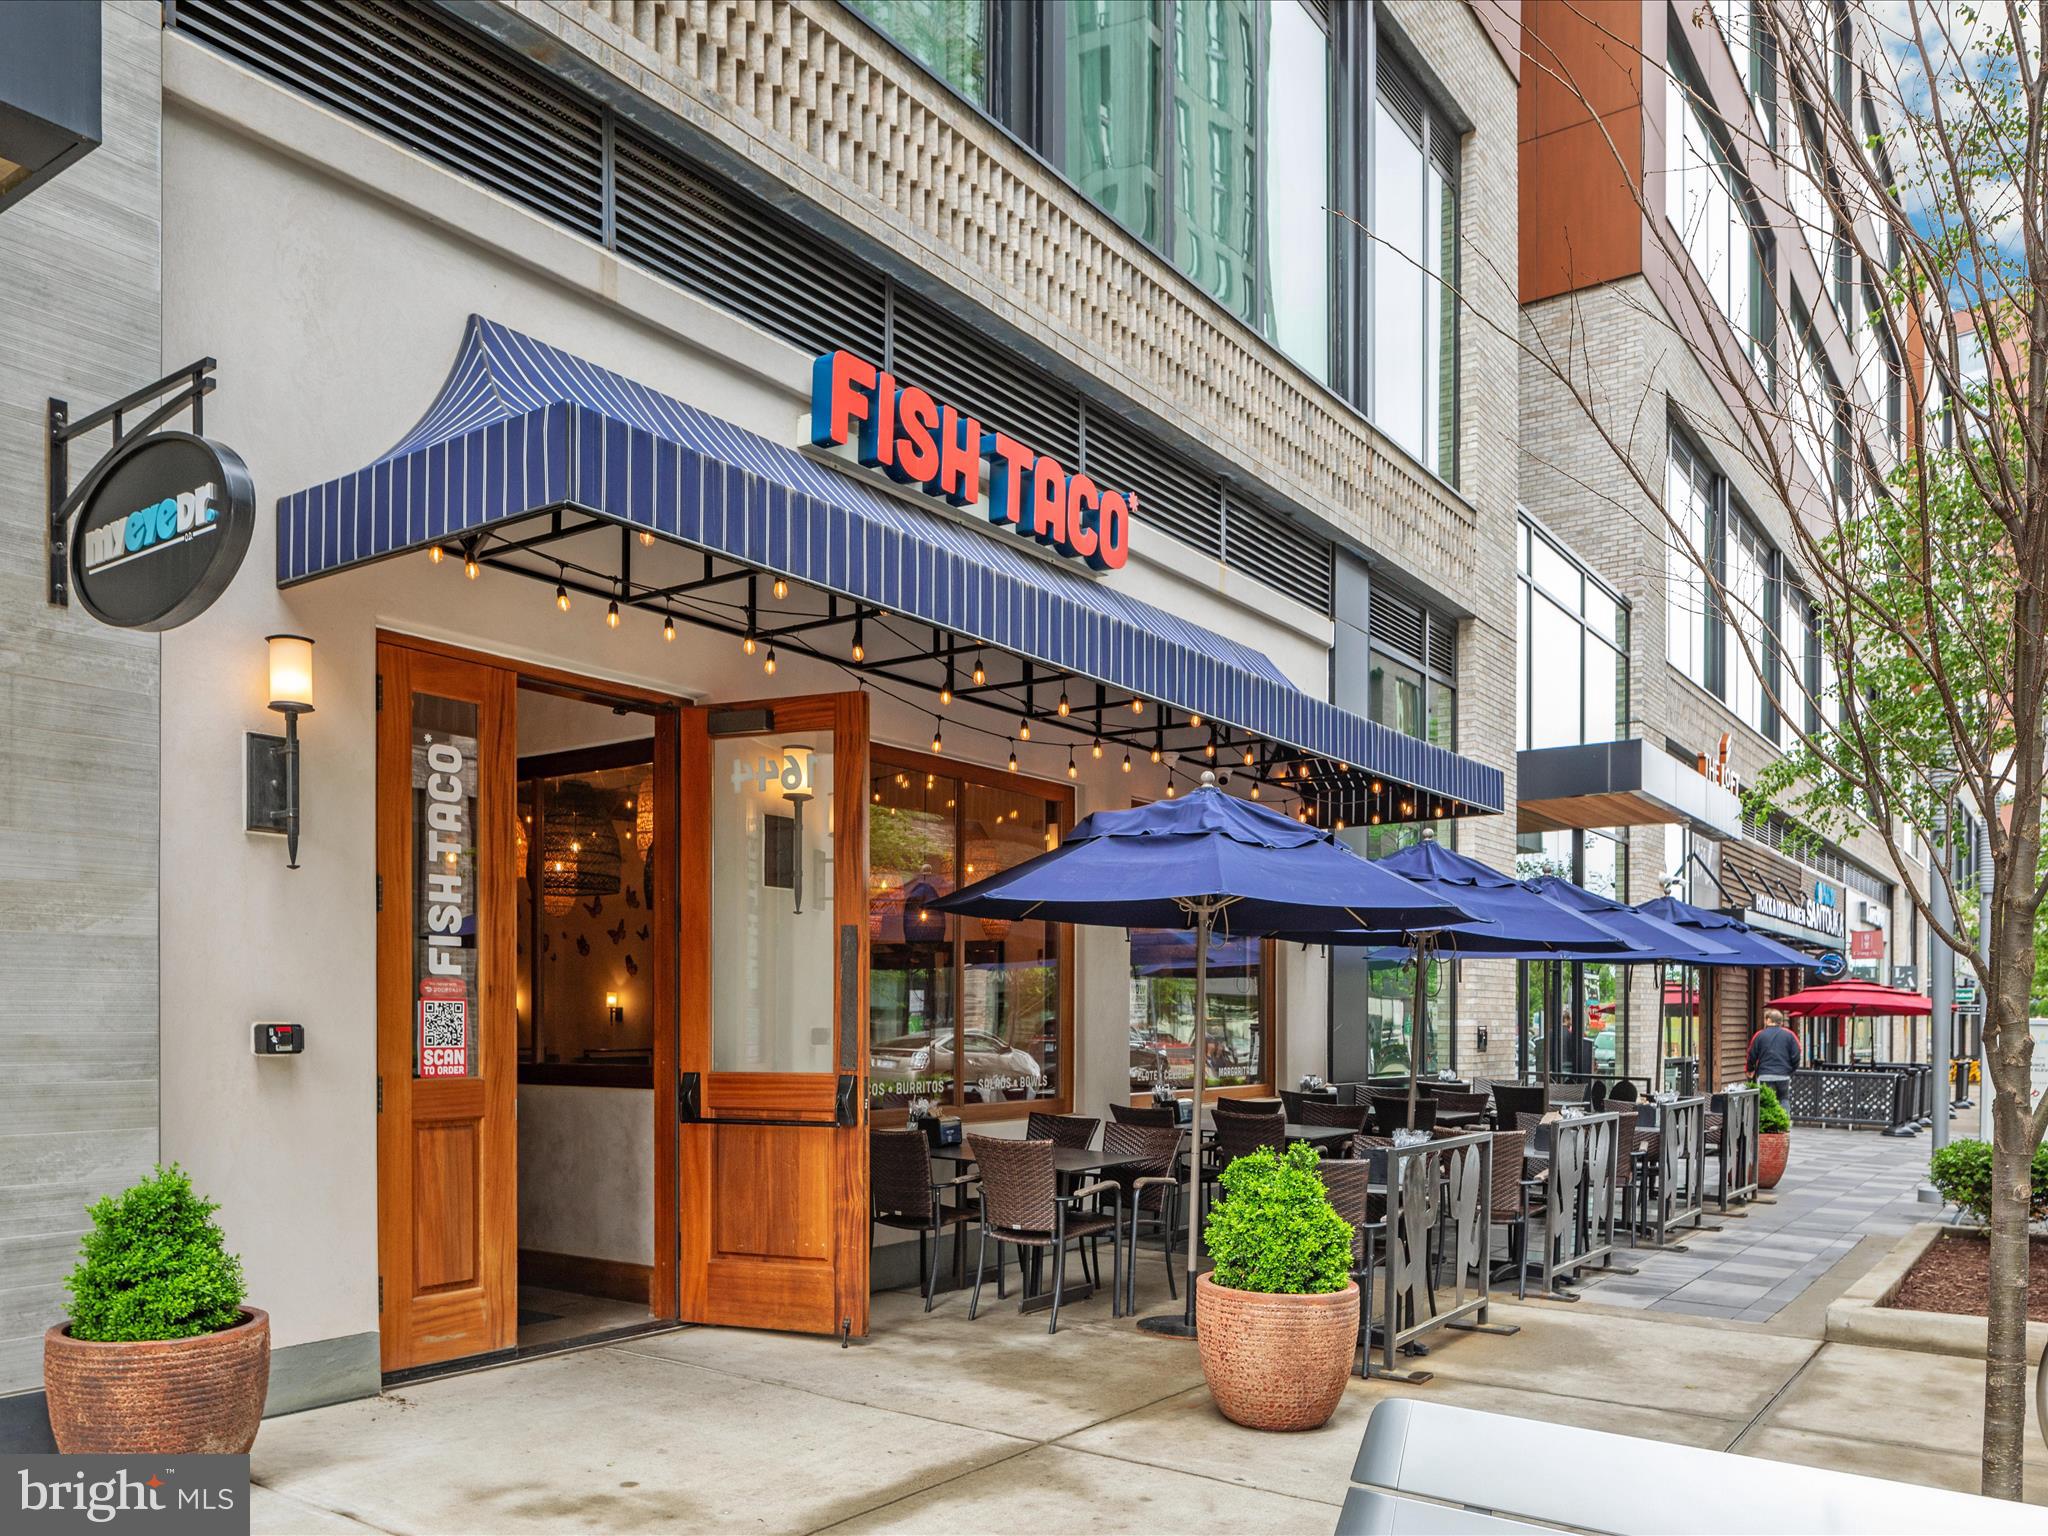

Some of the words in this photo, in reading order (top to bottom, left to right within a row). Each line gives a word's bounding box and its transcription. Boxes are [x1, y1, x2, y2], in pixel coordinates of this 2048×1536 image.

[831, 350, 980, 504] FISH
[996, 432, 1129, 570] TACO
[1704, 752, 1718, 786] THE
[1719, 763, 1740, 798] LOFT
[428, 743, 462, 862] TACO
[428, 873, 462, 975] FISH
[1756, 893, 1787, 919] HOKKAIDO
[1787, 903, 1806, 926] RAMEN
[1806, 898, 1844, 938] SANTOUKA
[423, 1049, 465, 1066] SCAN
[423, 1066, 435, 1075] TO
[437, 1066, 465, 1075] ORDER
[896, 1080, 945, 1095] BURRITOS
[978, 1077, 1011, 1090] SALADS
[1019, 1074, 1048, 1088] BOWLS
